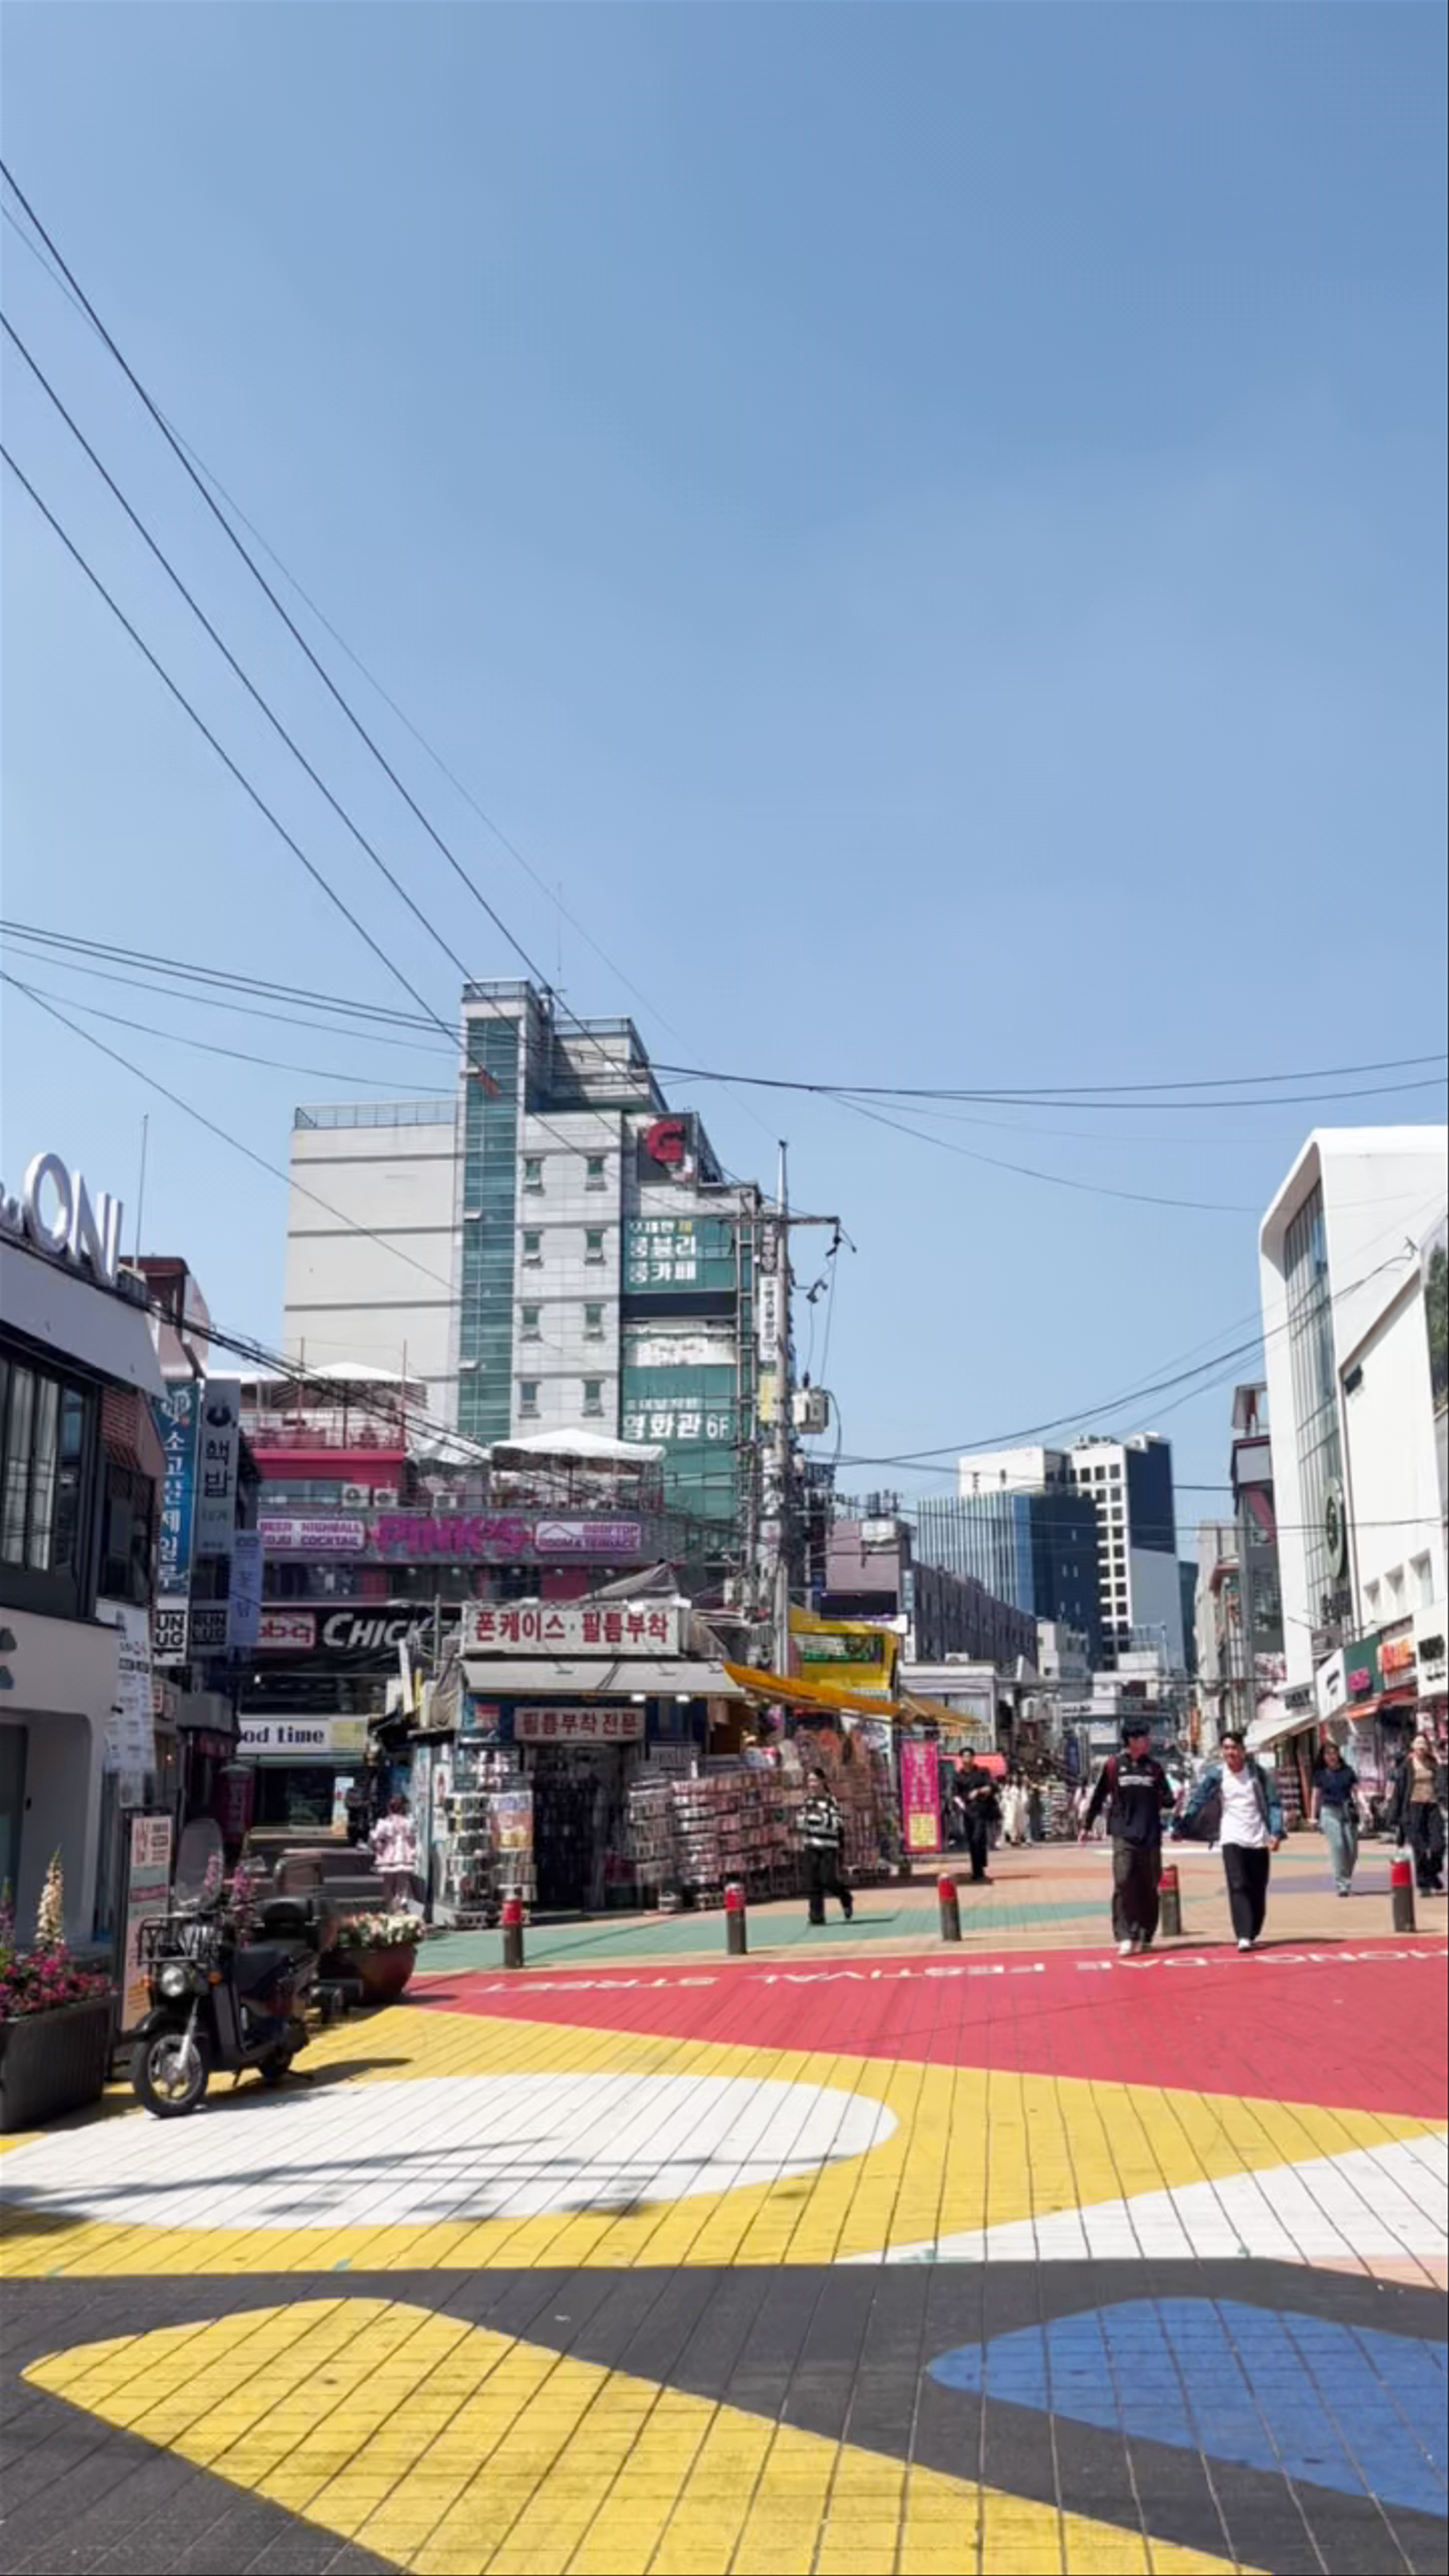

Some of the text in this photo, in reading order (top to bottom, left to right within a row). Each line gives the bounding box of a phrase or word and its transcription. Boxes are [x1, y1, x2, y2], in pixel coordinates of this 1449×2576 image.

[474, 1610, 669, 1643] 폰케이스 필름부착
[523, 1712, 638, 1735] 필름부착 전문
[243, 1726, 324, 1743] od time
[744, 1963, 1045, 1984] FESTIVAL
[470, 1977, 718, 1992] STREET
